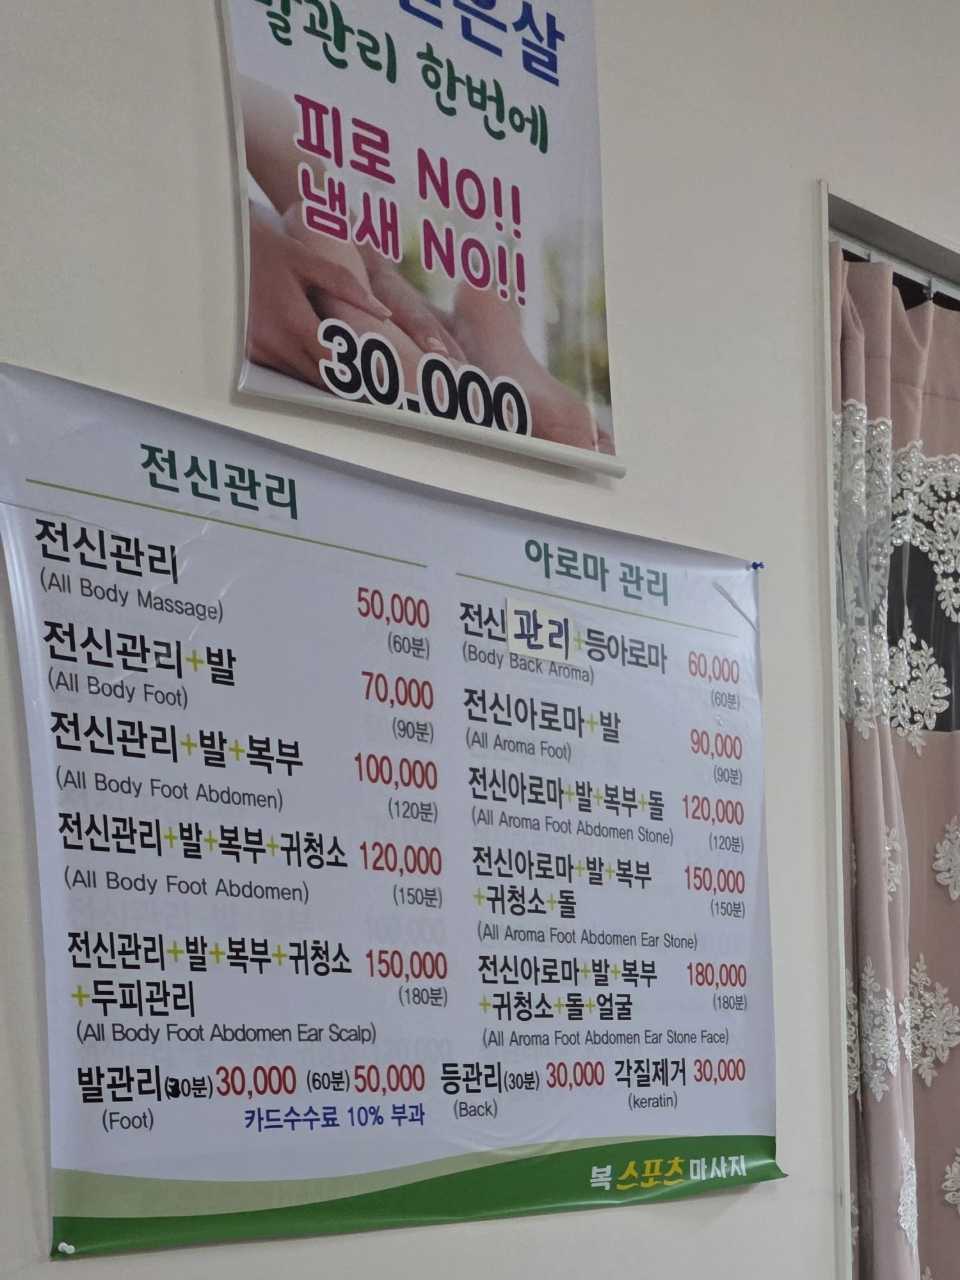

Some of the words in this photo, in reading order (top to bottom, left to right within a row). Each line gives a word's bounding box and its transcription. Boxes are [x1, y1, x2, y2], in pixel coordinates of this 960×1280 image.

[416, 42, 548, 154] 한번에
[293, 94, 396, 185] 피로
[416, 147, 523, 240] NO!!
[300, 167, 400, 262] 냄새
[422, 219, 527, 306] NO!!
[320, 322, 531, 436] 30.000
[139, 443, 299, 520] 전신관리
[35, 518, 180, 584] 전신관리
[524, 538, 610, 592] 아로마
[619, 560, 669, 606] 관리
[40, 566, 72, 594] (All
[80, 573, 129, 607] Body
[137, 589, 225, 624] Massage)
[356, 586, 431, 628] 50,000
[388, 631, 431, 660] (60분)
[462, 640, 504, 670] (Body
[509, 652, 543, 674] Back
[550, 661, 595, 686] Aroma)
[688, 651, 740, 684] 60,000
[48, 665, 79, 693] (All
[88, 672, 136, 703] Body
[143, 682, 189, 711] Foot)
[361, 671, 434, 710] 70,000
[711, 689, 741, 712] (60분)
[392, 717, 435, 744] (90분)
[466, 727, 489, 750] (All
[493, 731, 536, 757] Aroma
[540, 738, 572, 762] Foot)
[690, 729, 743, 761] 90,000
[354, 752, 438, 790] 100,000
[713, 765, 743, 787] (90분)
[56, 764, 87, 792] (All
[94, 770, 142, 800] Body
[150, 778, 189, 801] Foot
[196, 783, 284, 811] Abdomen)
[388, 797, 439, 824] (120분)
[471, 805, 495, 827] (All
[499, 811, 542, 834] Aroma
[545, 815, 573, 835] Foot
[577, 821, 634, 841] Abdomen
[638, 823, 674, 848] Stone)
[682, 795, 744, 826] 120,000
[359, 841, 443, 876] 120,000
[709, 831, 744, 854] (120분)
[64, 865, 97, 891] (All
[106, 871, 158, 896] Body
[167, 875, 208, 896] Foot
[215, 878, 310, 905] Abdomen)
[684, 865, 745, 895] 150,000
[393, 886, 443, 908] (150분)
[710, 899, 746, 919] (150분)
[477, 920, 500, 942] (All
[504, 924, 546, 944] Aroma
[549, 927, 577, 945] Foot
[580, 928, 637, 947] Abdomen
[641, 931, 660, 948] Ear
[663, 931, 698, 951] Stone)
[366, 948, 448, 980] 150,000
[686, 962, 747, 989] 180,000
[398, 985, 448, 1008] (180분)
[712, 993, 748, 1012] (180분)
[76, 1020, 106, 1045] (All
[112, 1024, 160, 1046] Body
[167, 1024, 204, 1042] Foot
[210, 1023, 293, 1043] Abdomen
[298, 1024, 325, 1042] Ear
[329, 1022, 378, 1046] Scalp)
[482, 1028, 505, 1049] (All
[509, 1030, 550, 1047] Aroma
[554, 1030, 581, 1046] Foot
[584, 1028, 641, 1046] Abdomen
[644, 1028, 663, 1046] Ear
[666, 1028, 699, 1046] Stone
[701, 1026, 730, 1047] Face)
[215, 1065, 297, 1099] 30,000
[306, 1068, 351, 1093] (60분)
[353, 1064, 426, 1096] 50,000
[546, 1061, 606, 1089] 30,000
[614, 1057, 687, 1089] 각질제거
[693, 1057, 746, 1085] 30,000
[244, 1105, 341, 1132] 카드수수료
[347, 1105, 385, 1128] 10%
[390, 1103, 426, 1127] 부과
[453, 1099, 498, 1120] (Back)
[628, 1092, 678, 1113] (keratin)
[102, 1108, 154, 1132] (Foot)
